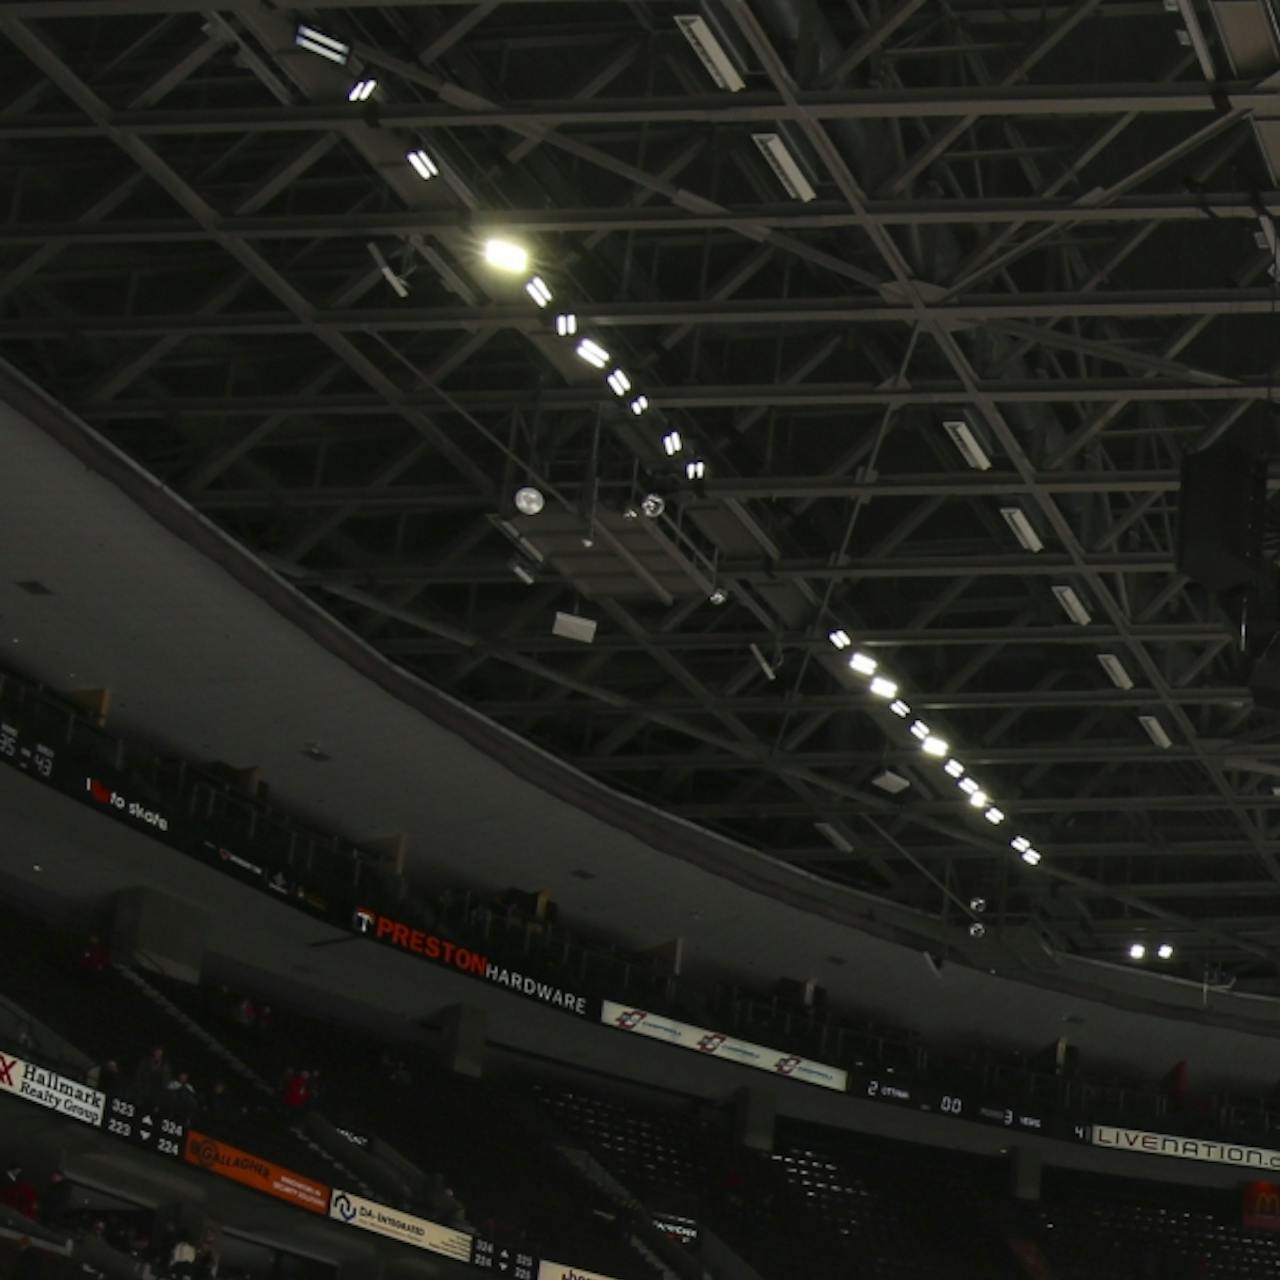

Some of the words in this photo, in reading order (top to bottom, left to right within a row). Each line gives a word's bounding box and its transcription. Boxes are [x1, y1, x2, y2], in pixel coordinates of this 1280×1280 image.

[110, 792, 125, 809] to
[129, 803, 168, 831] skate
[375, 916, 487, 977] PRESTON
[485, 964, 587, 1015] HARDWARE
[20, 1082, 61, 1110] Realty
[62, 1098, 100, 1123] Group
[23, 1064, 101, 1108] Hallmark
[867, 1080, 879, 1096] 2
[1003, 1109, 1013, 1125] 3
[108, 1118, 132, 1136] 223
[112, 1098, 135, 1117] 323
[160, 1119, 183, 1137] 324
